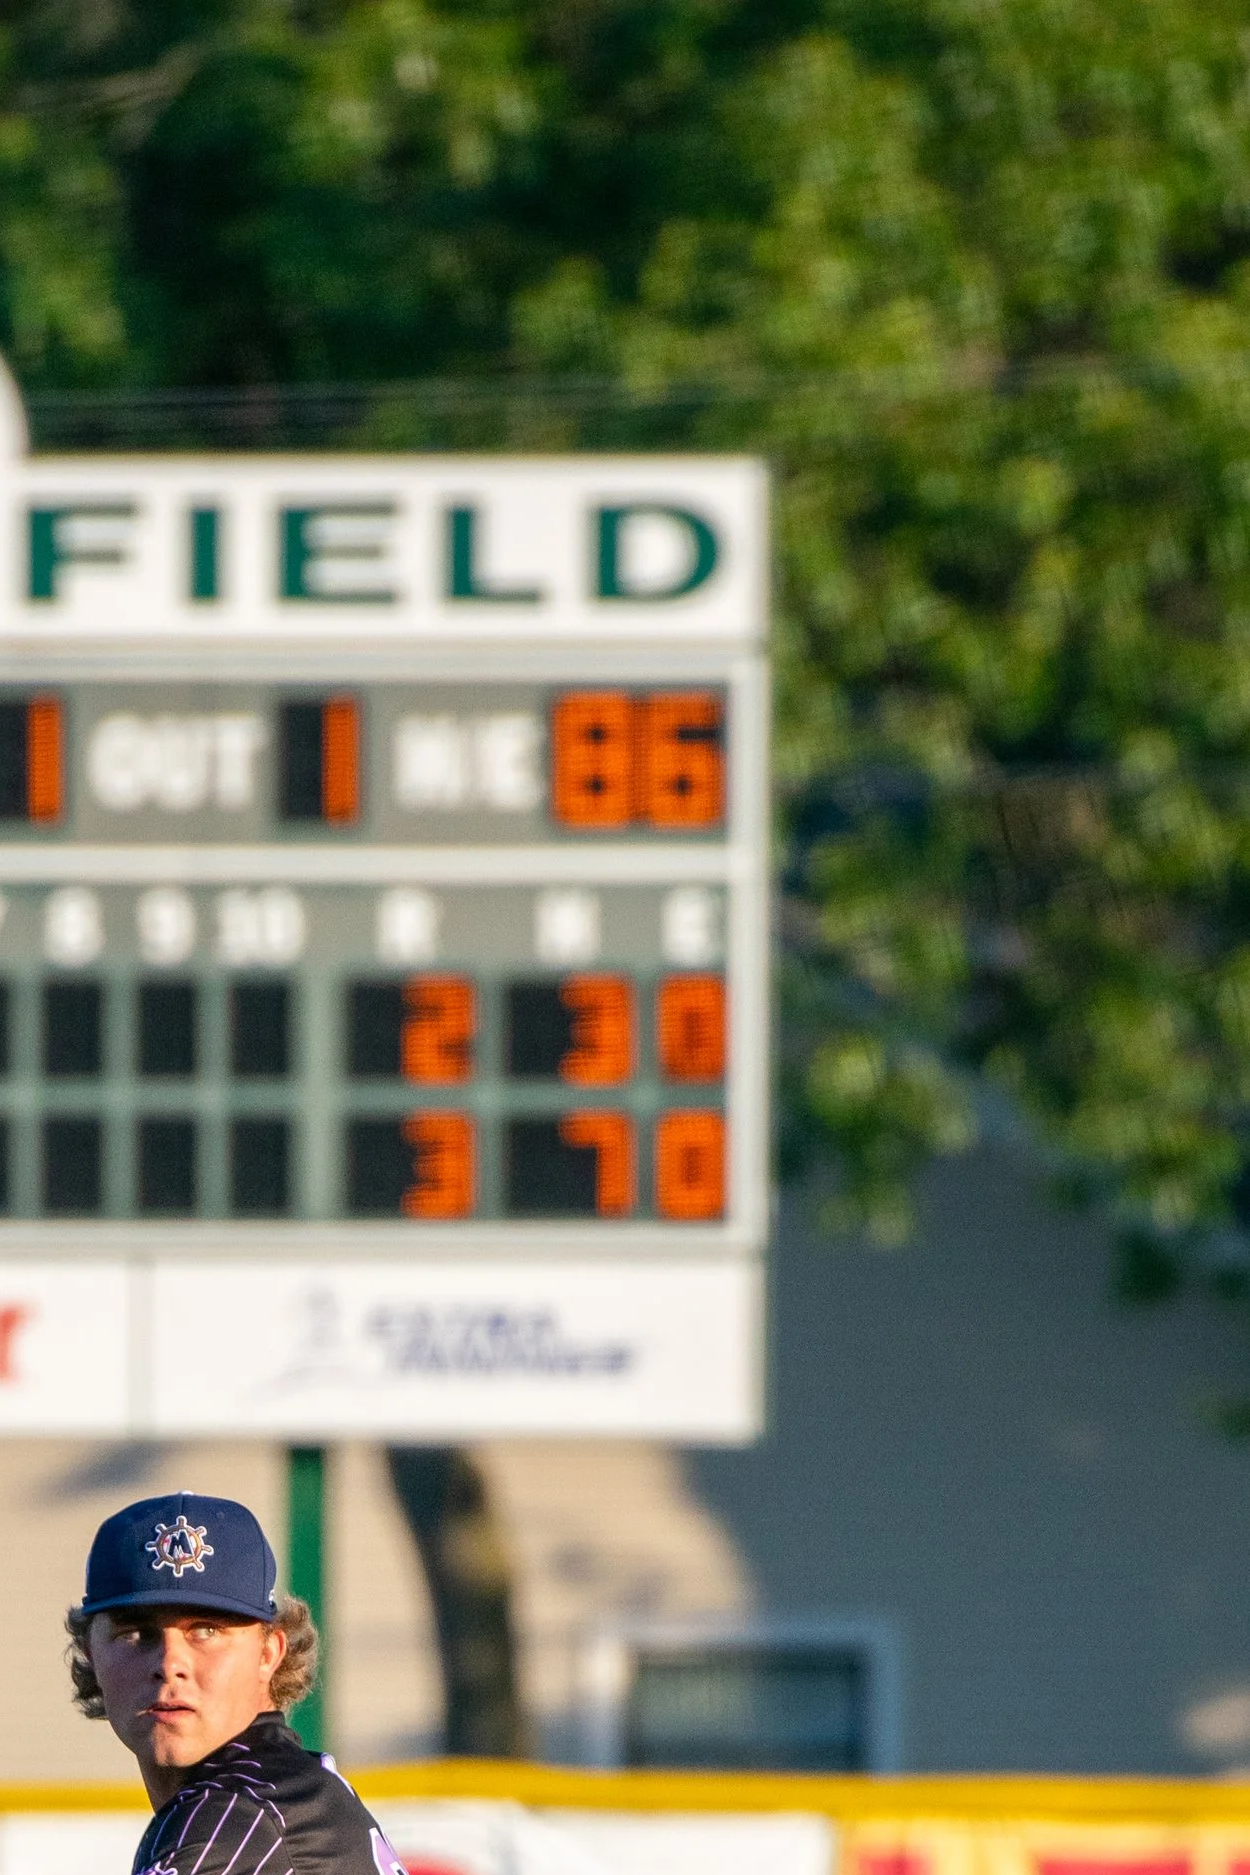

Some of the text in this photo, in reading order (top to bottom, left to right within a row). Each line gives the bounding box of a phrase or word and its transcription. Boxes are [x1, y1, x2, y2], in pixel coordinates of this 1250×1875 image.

[23, 500, 722, 605] FIELD
[26, 694, 63, 822] 1
[88, 712, 263, 808] OUT
[322, 694, 359, 822] 1
[46, 889, 101, 962] 8
[140, 889, 194, 962] 9
[218, 889, 305, 962] 10
[403, 976, 474, 1083] 2
[561, 976, 634, 1084] 3
[658, 976, 725, 1082] 0
[405, 1112, 474, 1217] 3
[561, 1112, 634, 1216] 7
[656, 1112, 725, 1219] 0
